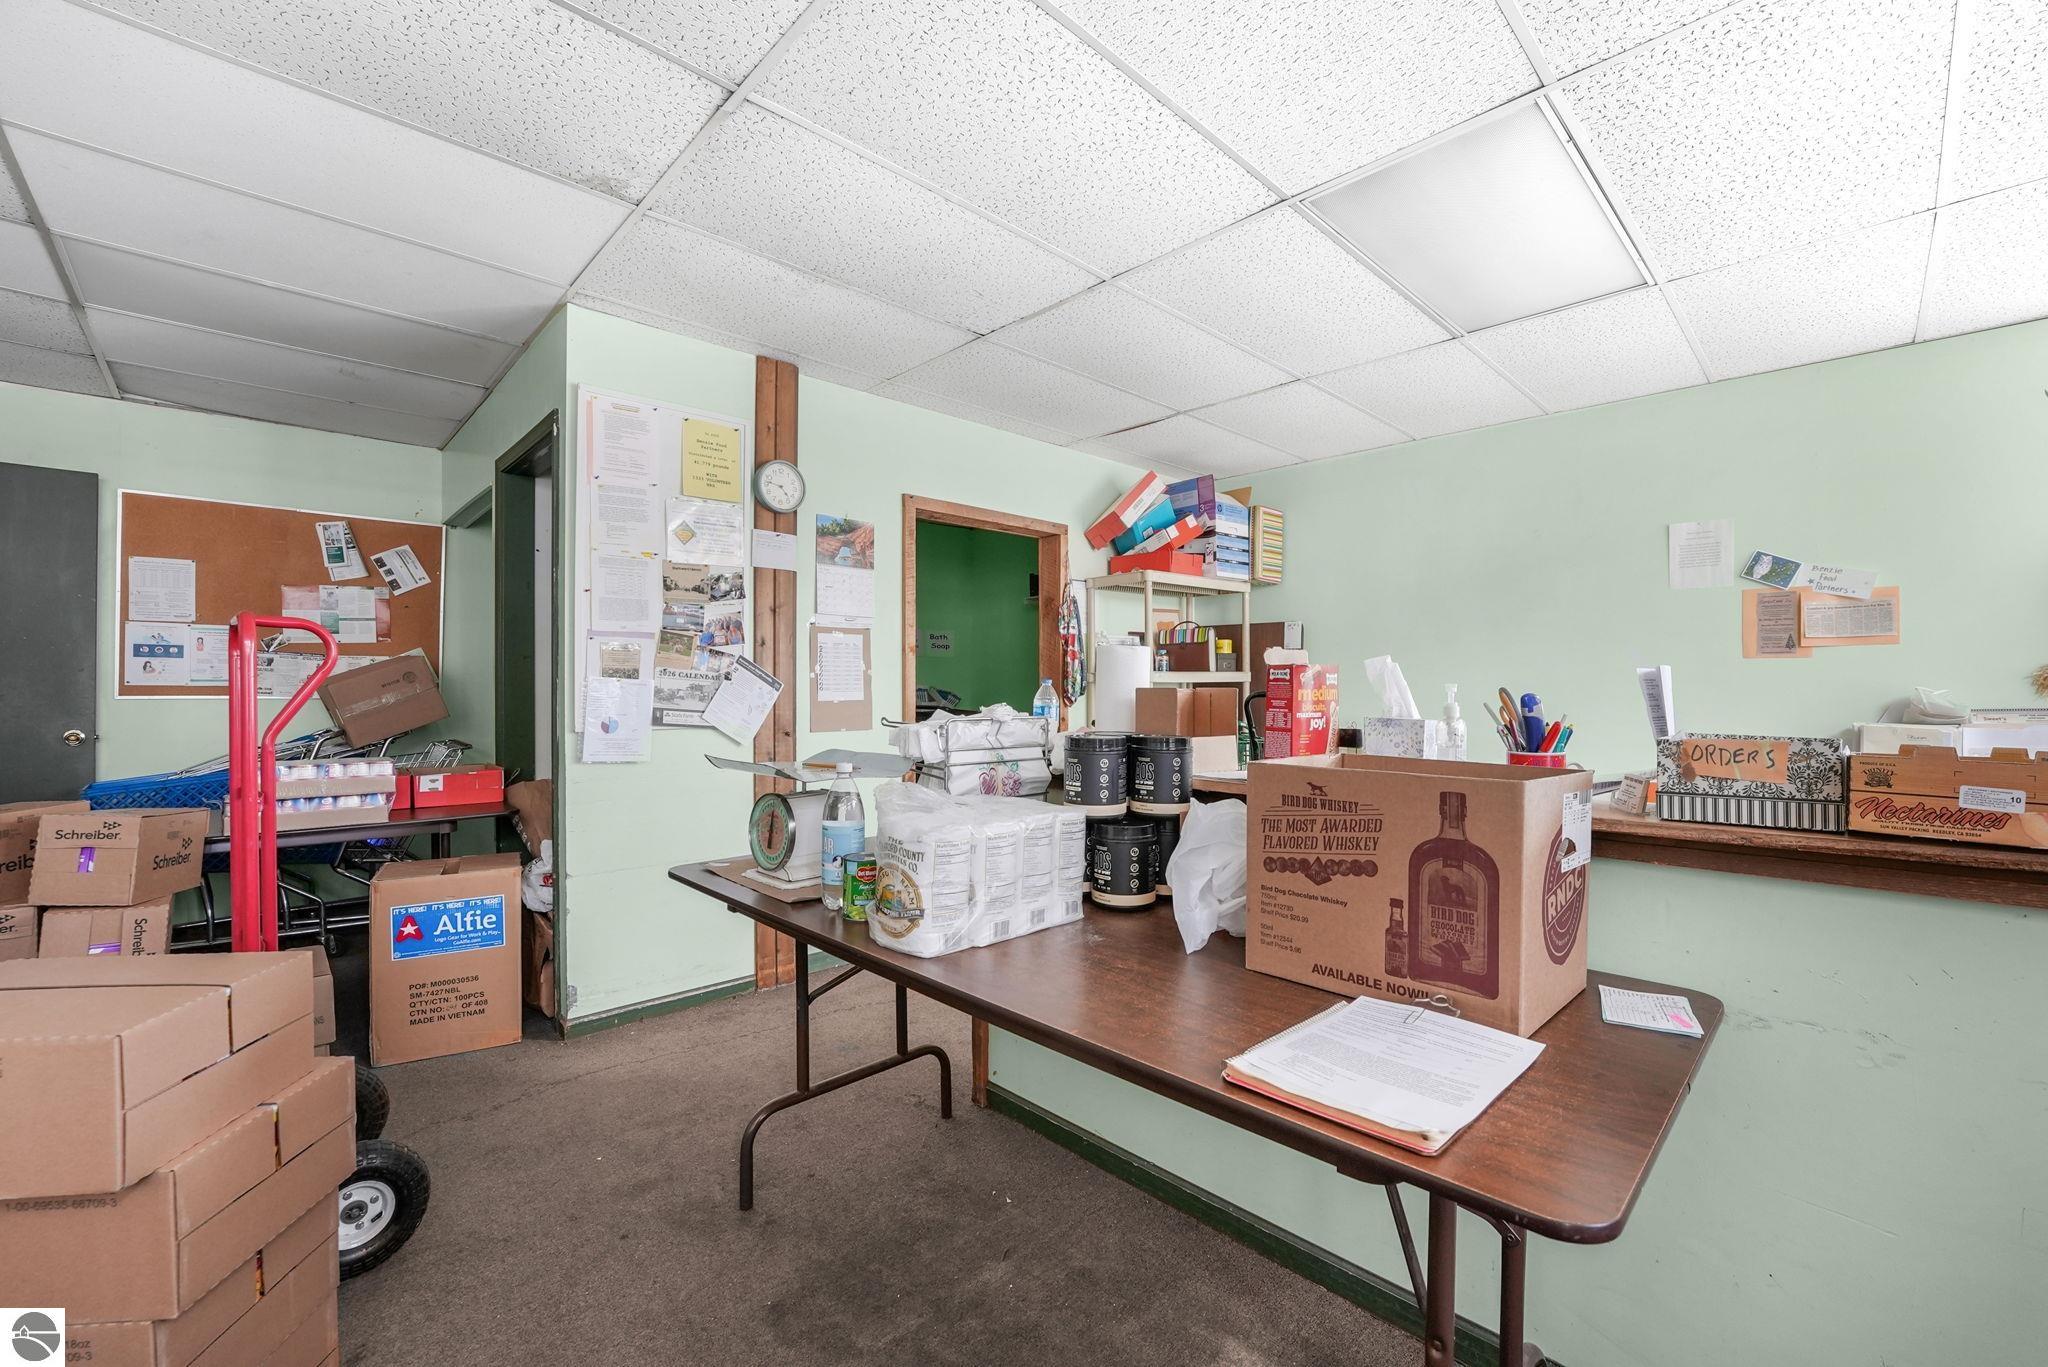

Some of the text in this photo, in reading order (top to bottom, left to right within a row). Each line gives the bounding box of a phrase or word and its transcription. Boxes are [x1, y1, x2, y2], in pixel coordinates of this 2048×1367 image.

[1811, 564, 1843, 574] Benzie
[1819, 574, 1838, 582] Food
[1814, 582, 1849, 594] Partners
[930, 643, 950, 651] Soap
[678, 672, 721, 681] CALENDAR
[1297, 686, 1338, 701] medium
[1690, 744, 1776, 769] ORDERS
[1282, 794, 1359, 813] BIRD DOG WHISKEY
[2010, 796, 2022, 804] 10
[1854, 796, 2012, 830] Nectarines
[1261, 818, 1383, 834] THE MOST AWARDED
[1263, 834, 1380, 851] FLAVORED WHISKEY
[898, 846, 925, 862] COUNTY
[1261, 884, 1348, 908] Bird Dog Chocolate Whiskey
[1548, 866, 1582, 923] RNDC
[408, 906, 427, 914] HERE!
[432, 903, 444, 911] IT'S
[446, 901, 464, 909] HERE!
[483, 897, 501, 905] HERE!
[433, 910, 497, 935] Alfie
[1275, 911, 1288, 919] Price
[1431, 906, 1475, 925] BIRD DOG
[1430, 920, 1475, 936] CHOCOLATE
[453, 938, 482, 946] GoAlfie.com
[1275, 941, 1288, 950] Price
[409, 975, 479, 991] PO#: M000030536
[1312, 964, 1382, 991] AVAILABLE
[410, 987, 461, 999] SM-7427NBL
[454, 991, 485, 1001] 100PCS
[409, 1009, 427, 1017] CTN
[430, 1006, 445, 1014] NO:
[461, 1001, 473, 1009] OF
[410, 1016, 435, 1026] MADE
[448, 1008, 485, 1020] VIETNAM
